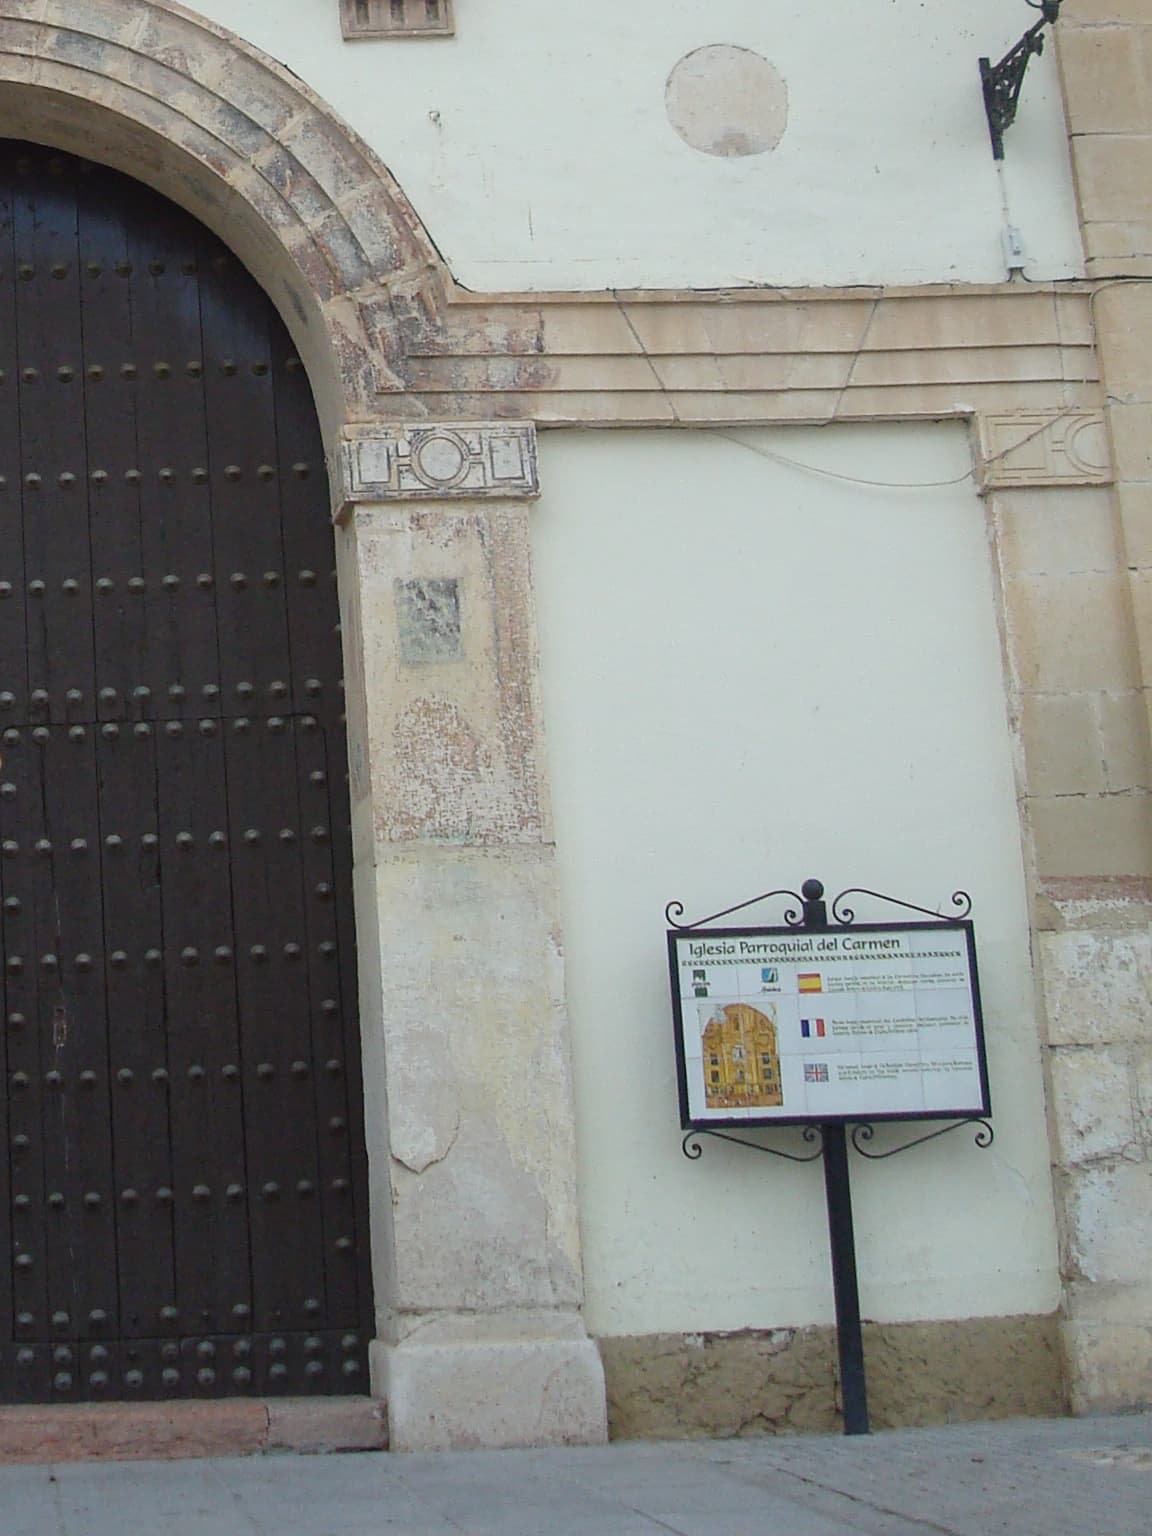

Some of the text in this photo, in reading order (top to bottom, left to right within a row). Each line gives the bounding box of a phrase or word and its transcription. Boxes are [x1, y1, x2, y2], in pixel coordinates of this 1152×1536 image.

[689, 937, 901, 959] Iglesia Parroquial del Carmen
